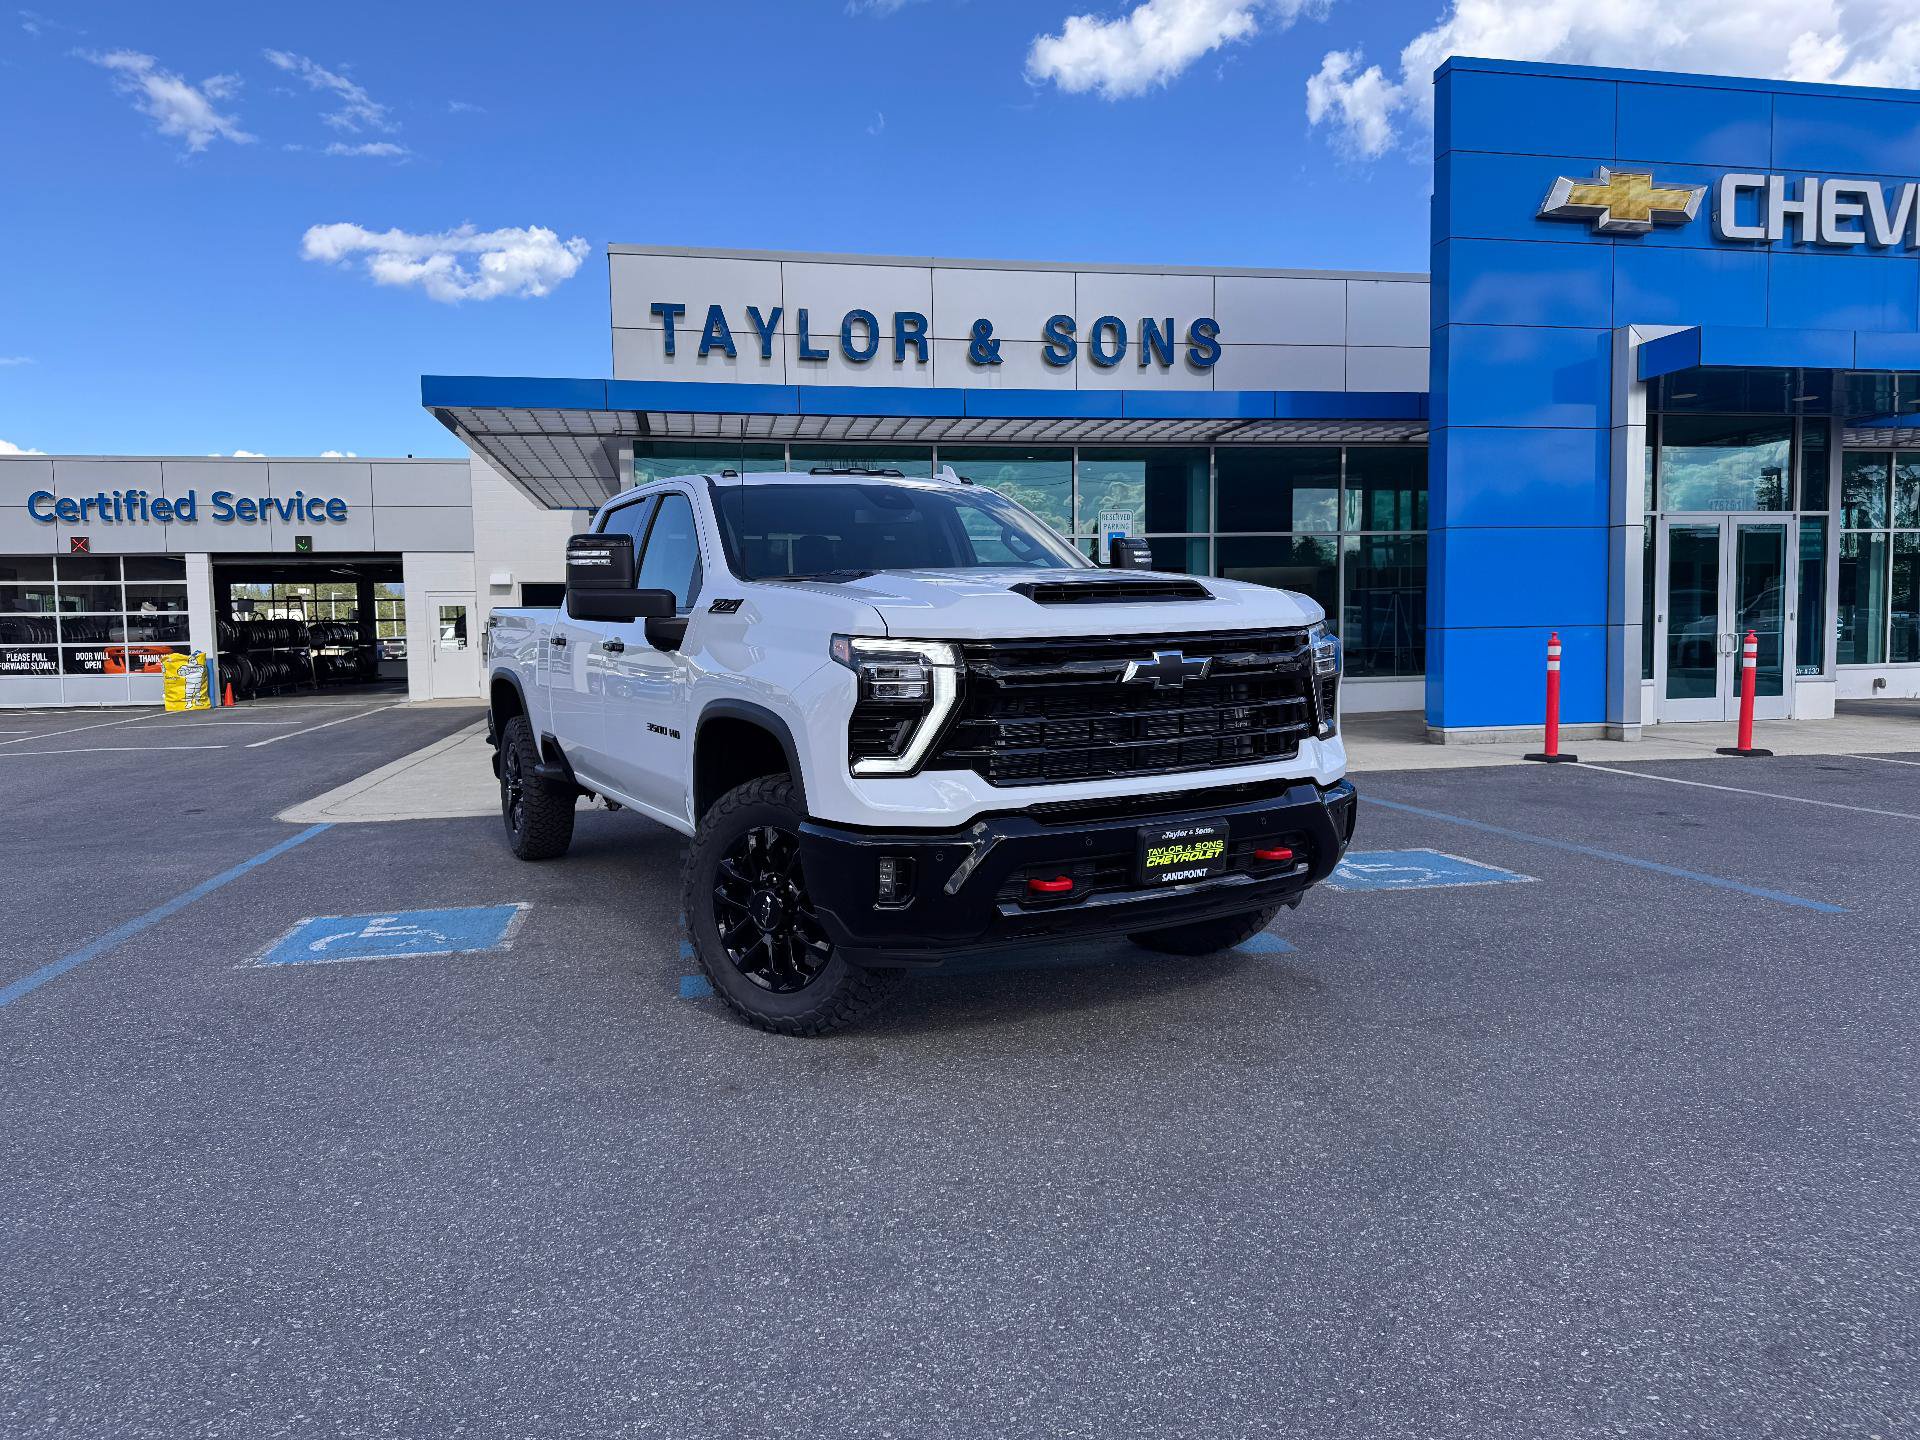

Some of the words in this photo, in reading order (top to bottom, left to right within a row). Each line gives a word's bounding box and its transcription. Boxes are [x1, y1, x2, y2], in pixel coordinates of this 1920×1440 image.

[1713, 173, 1920, 249] CHEV
[651, 303, 929, 363] TAYLOR
[969, 318, 1003, 365] &
[1044, 314, 1222, 367] SONS
[27, 490, 198, 522] Certified
[211, 490, 348, 522] Service
[1101, 513, 1131, 521] RESERVED
[1103, 522, 1129, 530] PARKING
[6, 652, 31, 662] PLEASE
[31, 652, 48, 662] PULL
[75, 652, 93, 661] DOOR
[93, 651, 111, 661] WILL
[139, 654, 160, 663] THANK
[30, 661, 56, 670] SLOWLY
[84, 661, 102, 670] OPEN
[646, 722, 668, 736] 3500
[668, 728, 681, 740] HD
[1164, 830, 1188, 840] Taylor
[1147, 844, 1183, 857] TAYLOR
[1185, 844, 1192, 853] &
[1194, 840, 1224, 850] SONS
[1146, 848, 1224, 867] CHEVROLET
[1161, 868, 1208, 882] SANDPOINT
